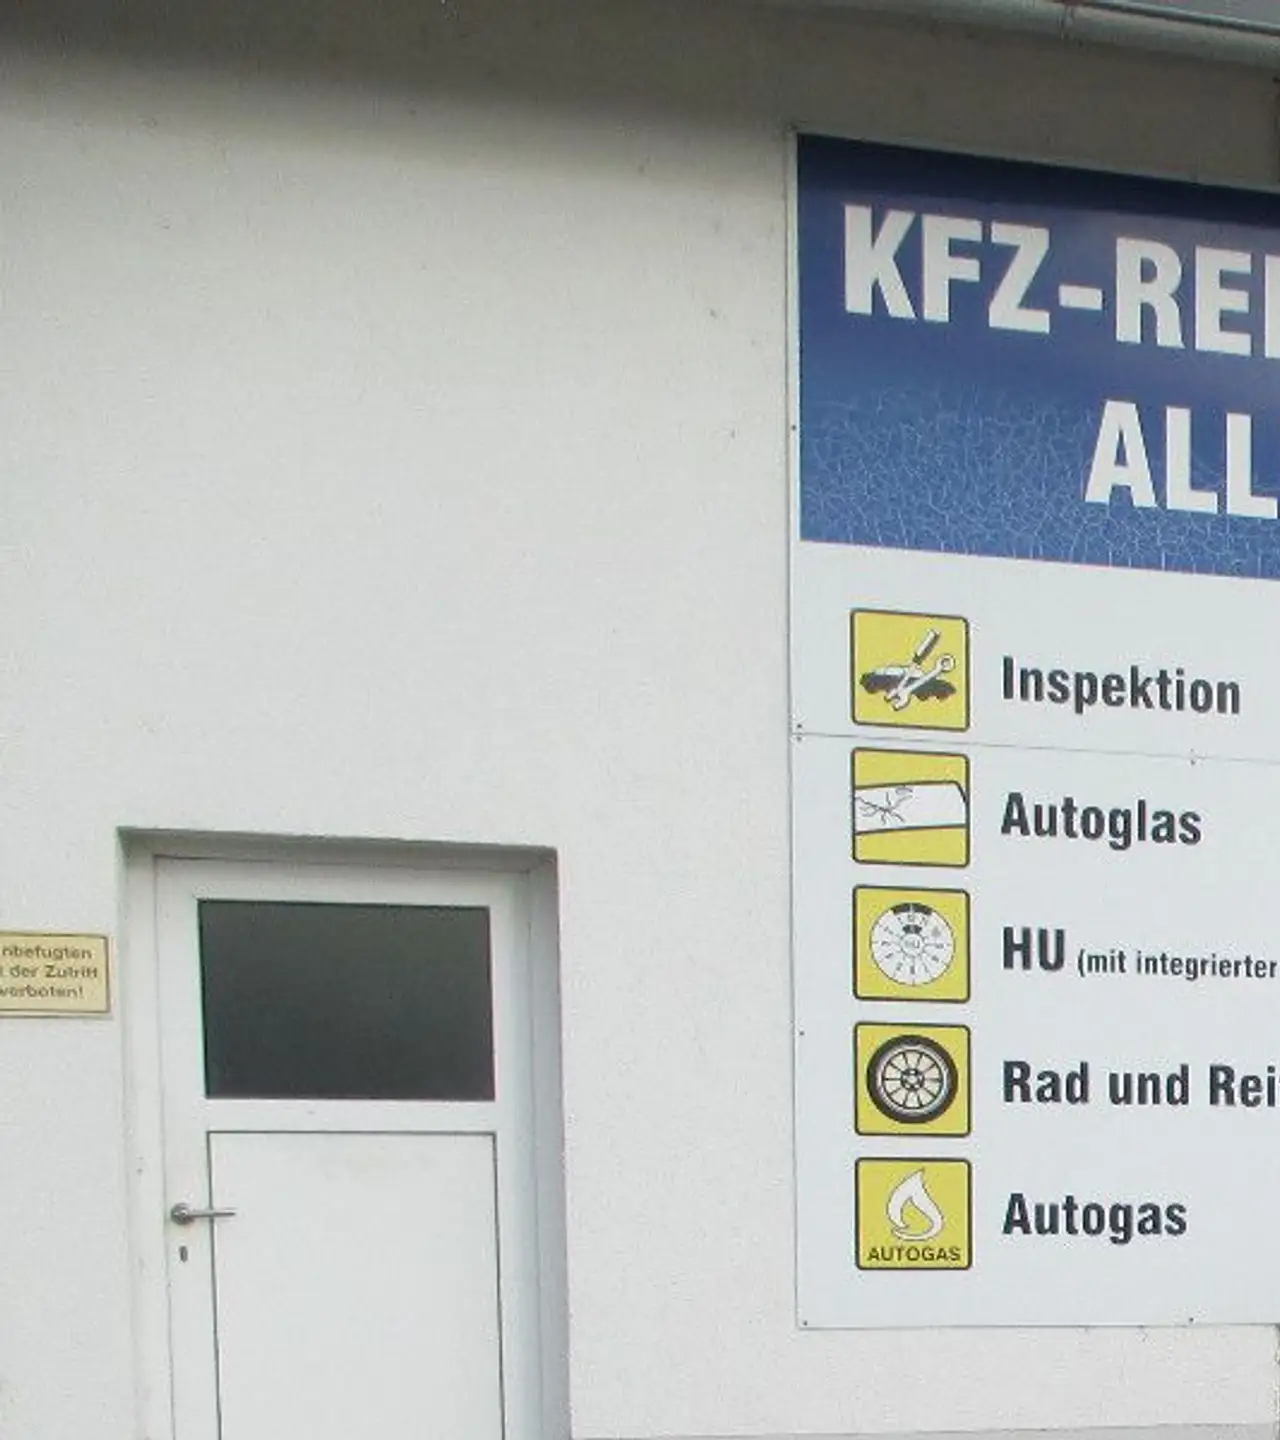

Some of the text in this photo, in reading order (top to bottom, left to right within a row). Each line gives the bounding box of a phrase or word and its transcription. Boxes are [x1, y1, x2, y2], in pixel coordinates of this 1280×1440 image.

[1002, 656, 1240, 715] Inspektion
[1000, 792, 1201, 851] Autoglas
[1002, 927, 1065, 972] HU
[1077, 947, 1126, 978] (mit
[1135, 951, 1277, 981] integrierter
[1002, 1060, 1089, 1106] Rad
[1108, 1064, 1190, 1107] und
[1002, 1193, 1187, 1245] Autogas
[867, 1246, 961, 1262] AUTOGAS
